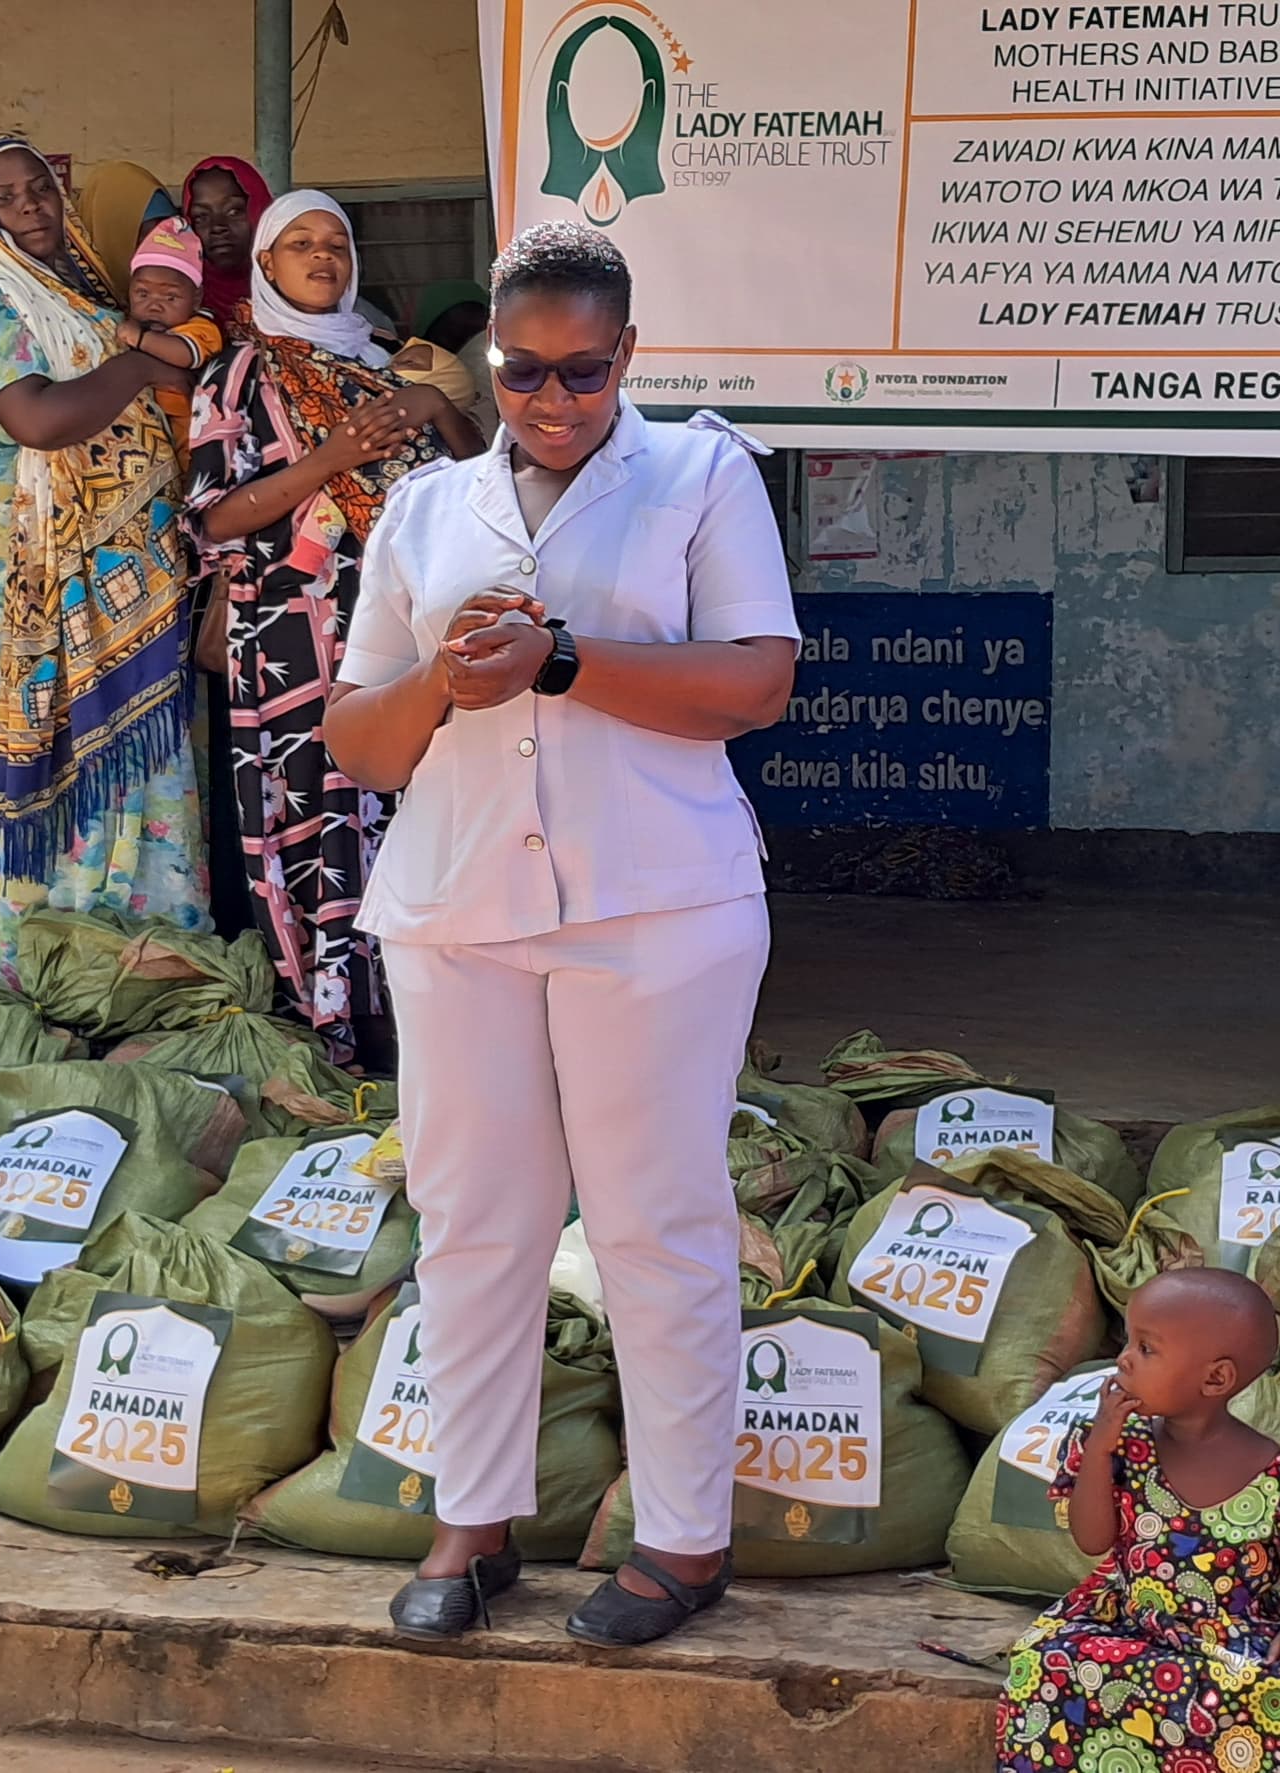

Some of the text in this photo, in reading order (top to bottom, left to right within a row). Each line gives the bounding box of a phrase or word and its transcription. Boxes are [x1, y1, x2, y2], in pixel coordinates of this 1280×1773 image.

[981, 7, 1060, 31] LADY
[1069, 5, 1208, 30] FATEMAH
[994, 42, 1139, 67] MOTHERS
[1147, 41, 1209, 64] AND
[672, 83, 719, 108] THE
[1013, 79, 1124, 103] HEALTH
[676, 110, 883, 138] LADY FATEMAH
[672, 141, 892, 167] CHARITABLE TRUST
[952, 139, 1066, 163] ZAWADI
[1072, 138, 1137, 161] KWA
[1145, 137, 1214, 160] KINA
[941, 179, 1062, 203] WATOTO
[1072, 179, 1114, 202] WA
[1122, 178, 1209, 202] MKOA
[1220, 178, 1263, 201] WA
[931, 221, 1009, 244] IKIWA
[1017, 221, 1048, 244] NI
[1055, 220, 1183, 244] SEHEMU
[1192, 219, 1225, 243] YA
[924, 262, 955, 284] YA
[960, 262, 1032, 284] AFYA
[1043, 262, 1075, 284] YA
[1083, 261, 1170, 284] MAMA
[1179, 261, 1218, 284] NA
[978, 302, 1060, 325] LADY
[1064, 302, 1206, 325] FATEMAH
[619, 374, 755, 393] artnership with
[875, 374, 1008, 386] NYOTA FOUNDATION
[1091, 371, 1203, 400] TANGA
[798, 626, 1026, 675] ala ndani ya
[921, 689, 1045, 736] chenye
[761, 752, 841, 788] dawa
[851, 750, 907, 789] kila
[938, 1129, 1033, 1146] RAMADAN
[286, 1186, 376, 1205] RAMADAN
[263, 1198, 375, 1235] 2025
[887, 1242, 988, 1275] RAMADAN
[862, 1256, 990, 1316] 2025
[89, 1389, 184, 1422] RAMADAN
[744, 1408, 859, 1434] RAMADAN
[71, 1412, 189, 1466] 2025
[734, 1432, 868, 1483] 2025
